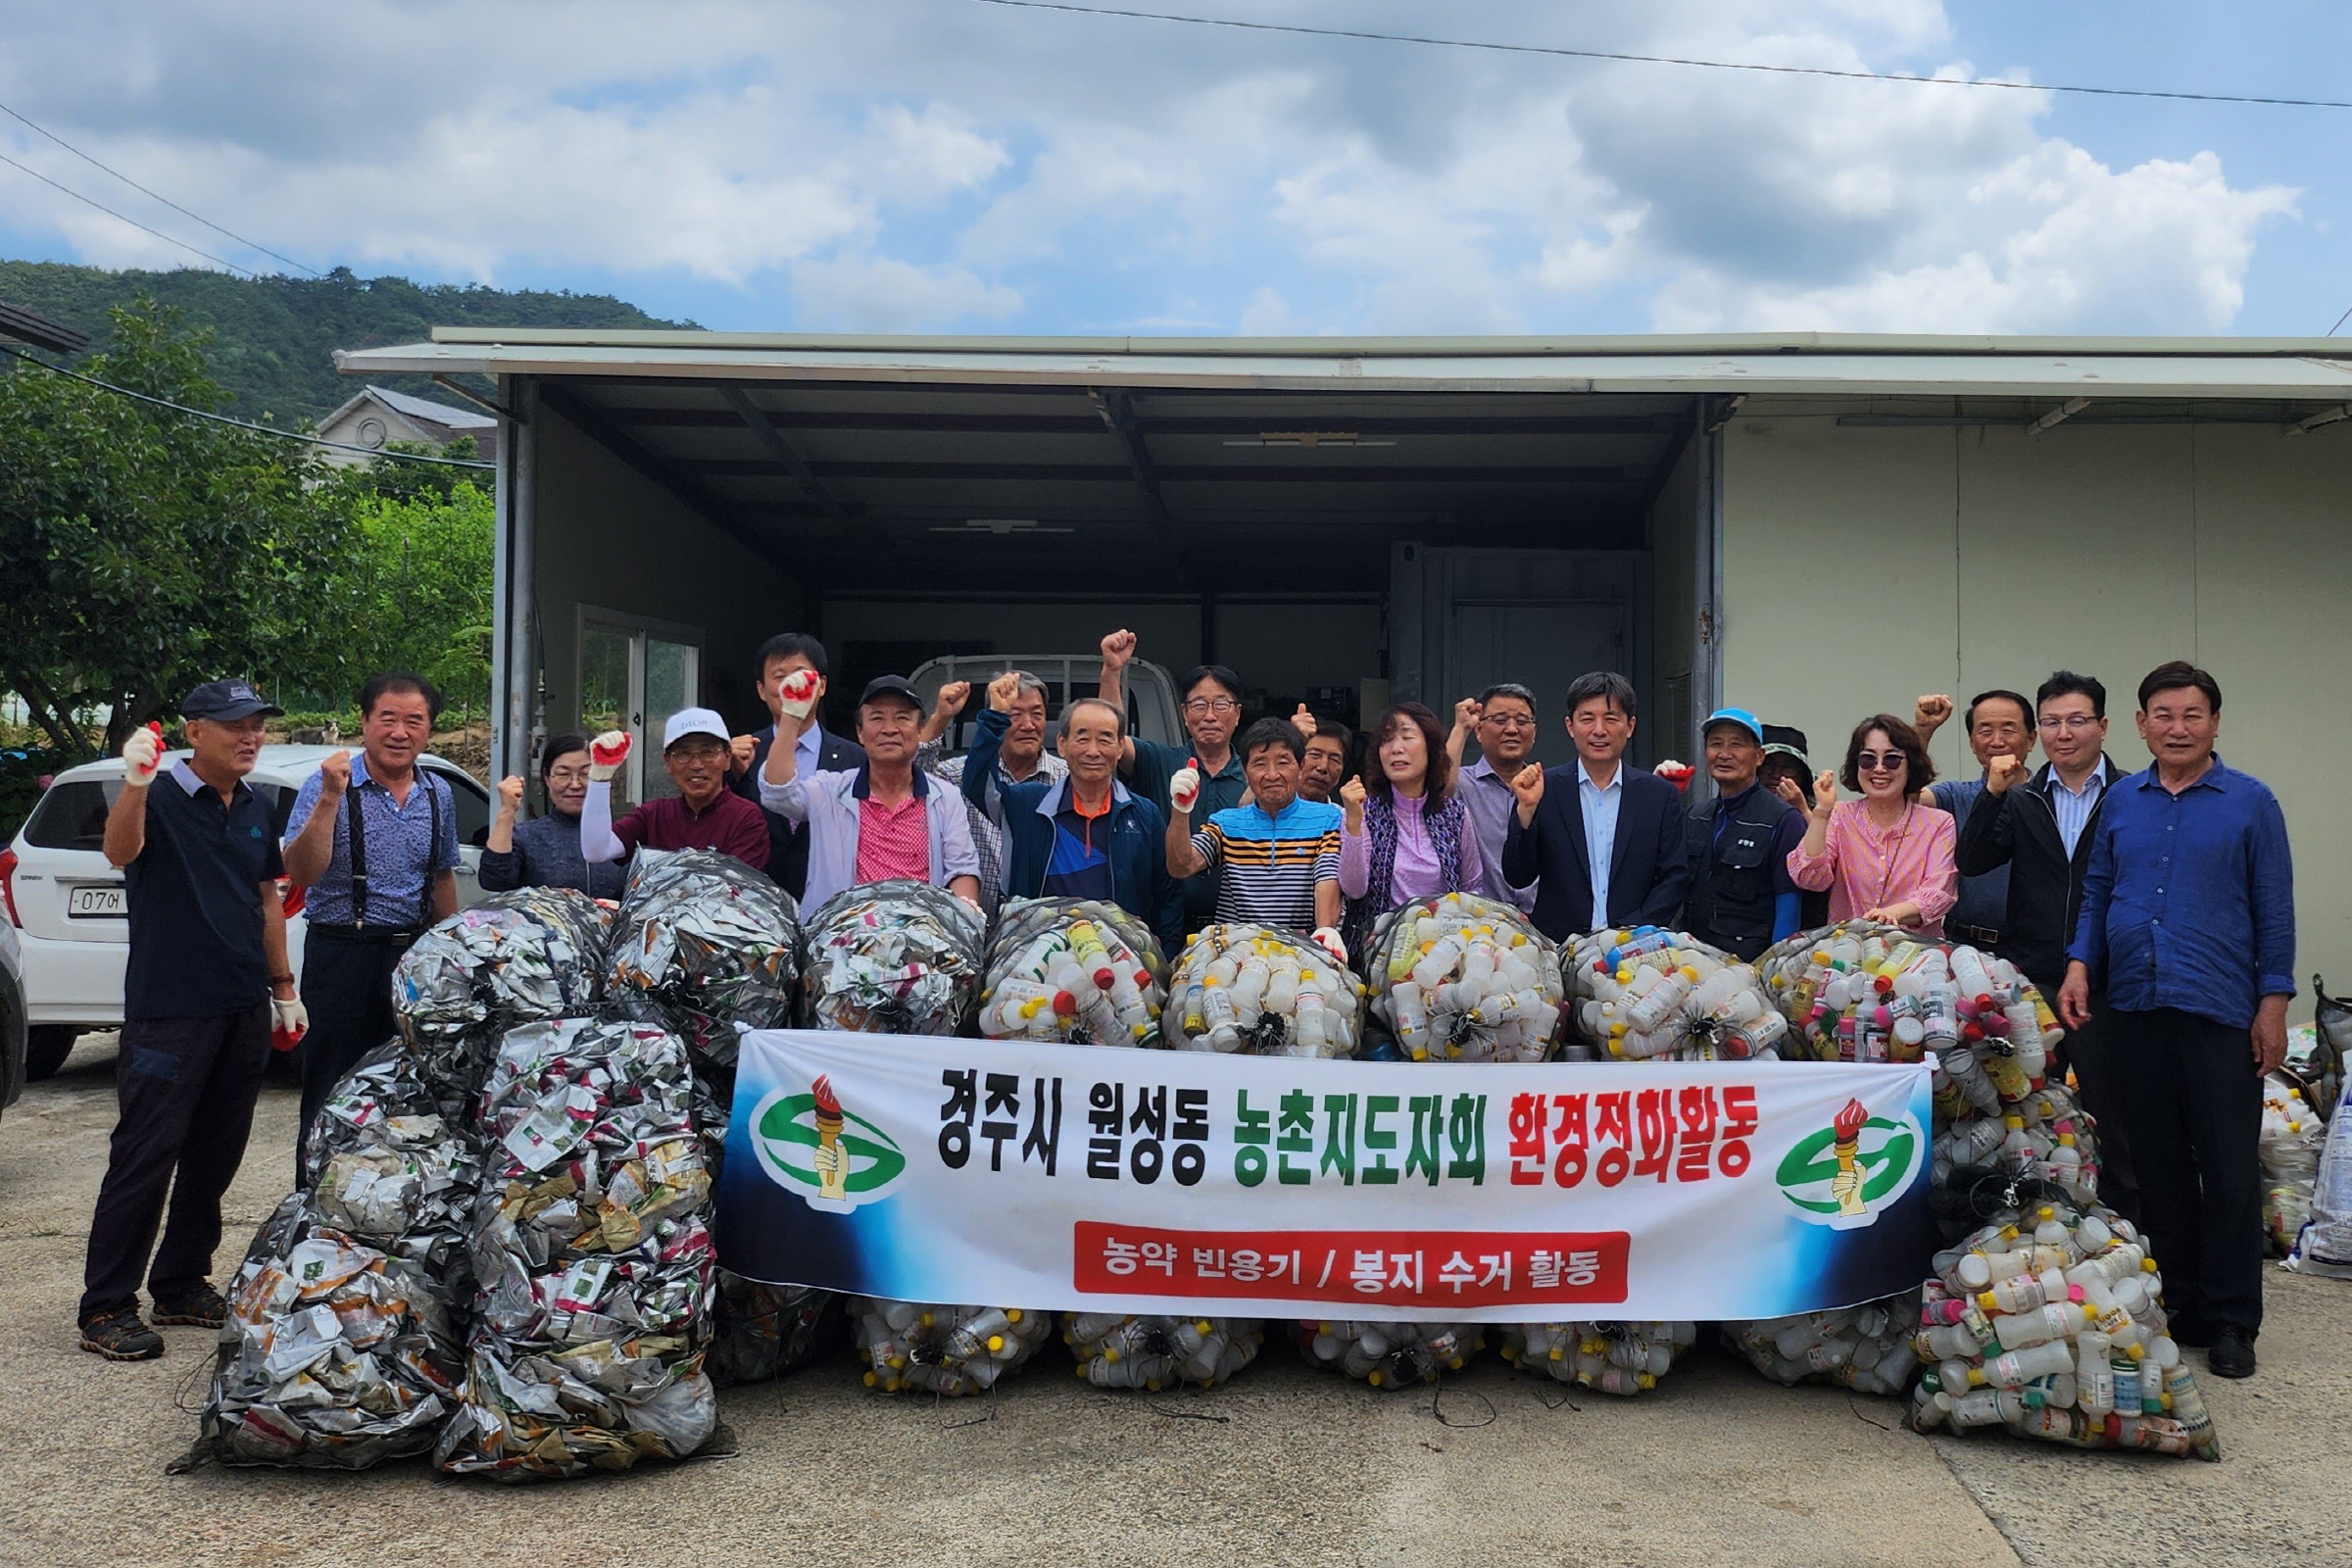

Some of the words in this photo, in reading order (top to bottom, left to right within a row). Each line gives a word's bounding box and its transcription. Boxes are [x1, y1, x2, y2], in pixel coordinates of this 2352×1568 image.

[938, 1068, 1062, 1177] 경주시
[1087, 1082, 1209, 1186] 월성동
[1234, 1088, 1488, 1188] 농촌지도자회
[1508, 1085, 1759, 1189] 환경정화활동
[1102, 1237, 1178, 1277] 농약
[1193, 1248, 1300, 1286] 빈용기
[1316, 1250, 1337, 1289] /
[1349, 1250, 1424, 1295] 봉지
[1439, 1250, 1512, 1295] 수거
[1528, 1250, 1601, 1290] 활동
